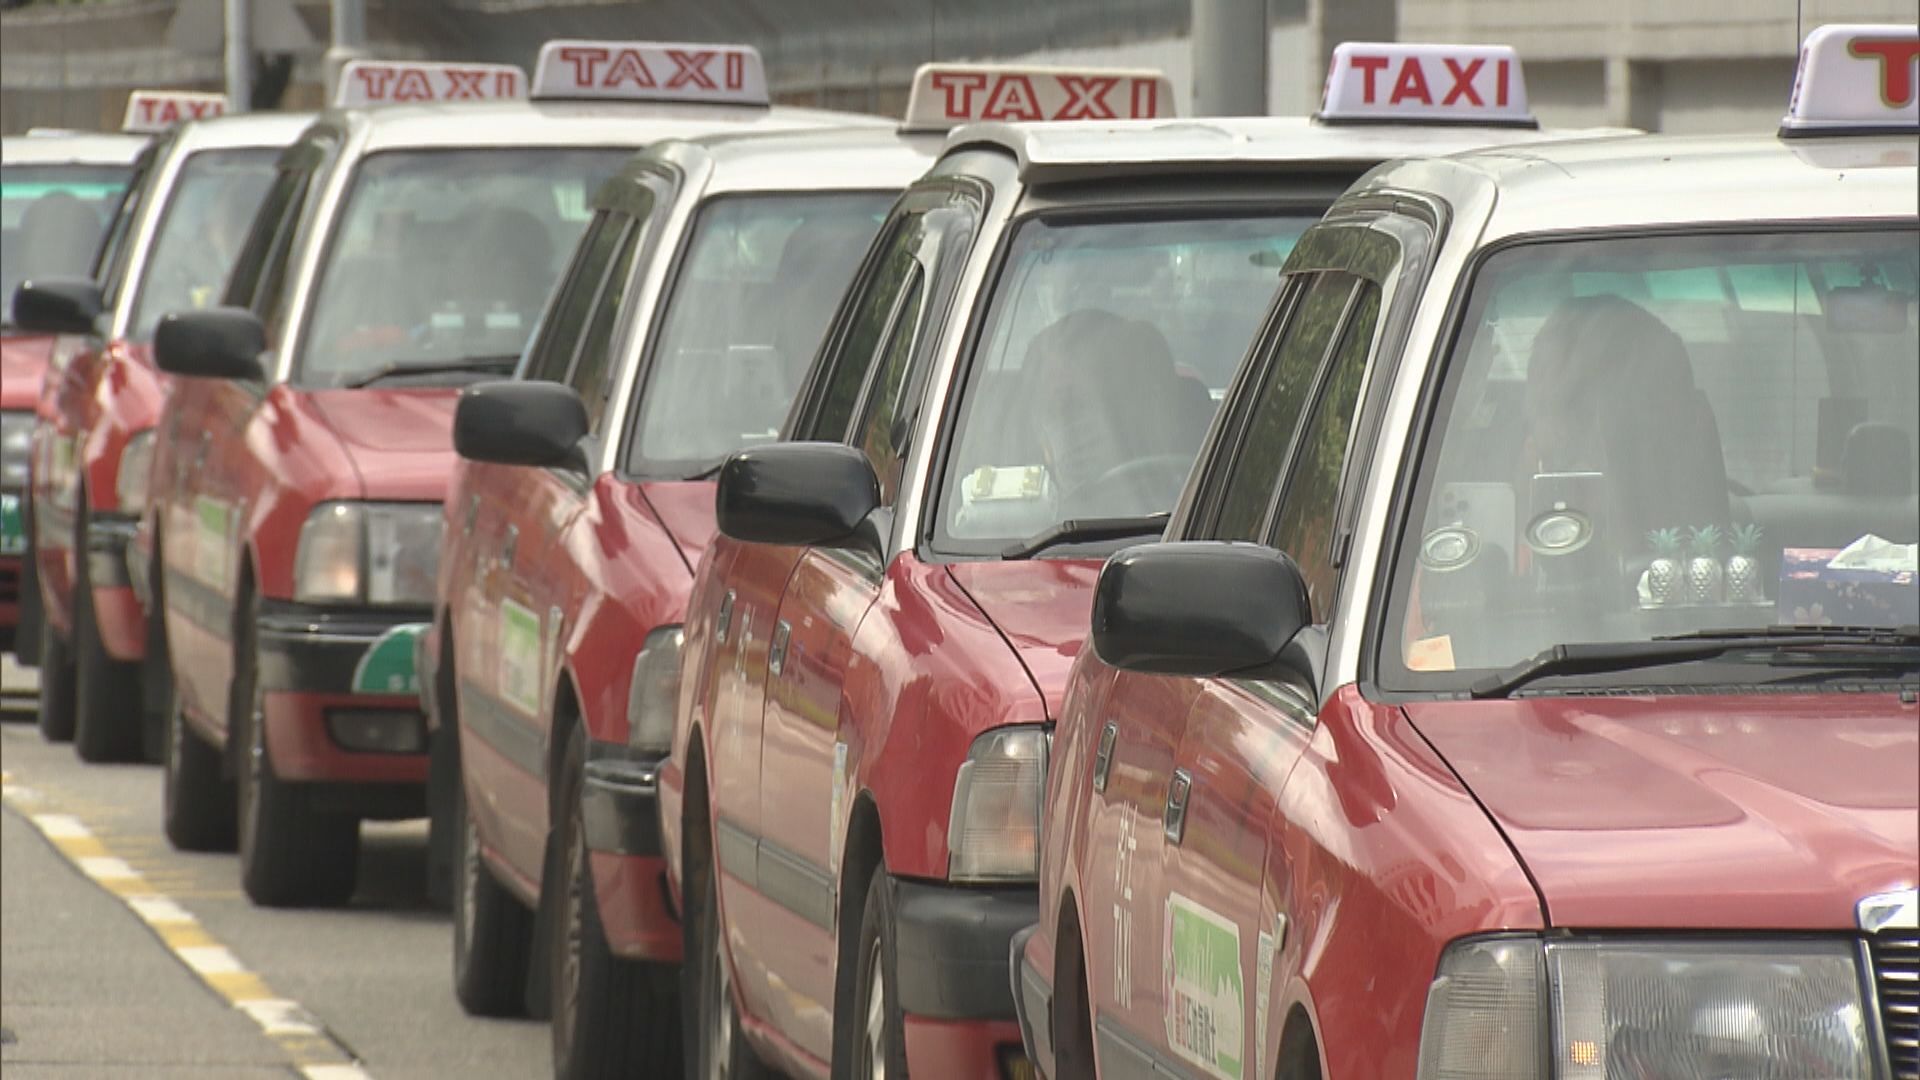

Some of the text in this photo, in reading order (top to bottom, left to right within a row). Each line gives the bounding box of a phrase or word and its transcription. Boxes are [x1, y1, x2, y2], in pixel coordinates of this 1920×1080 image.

[357, 67, 516, 101] TAXI
[561, 48, 745, 92] TAXI
[1350, 55, 1510, 108] TAXI
[931, 71, 1158, 121] TAXI
[1113, 903, 1132, 1010] TAXI
